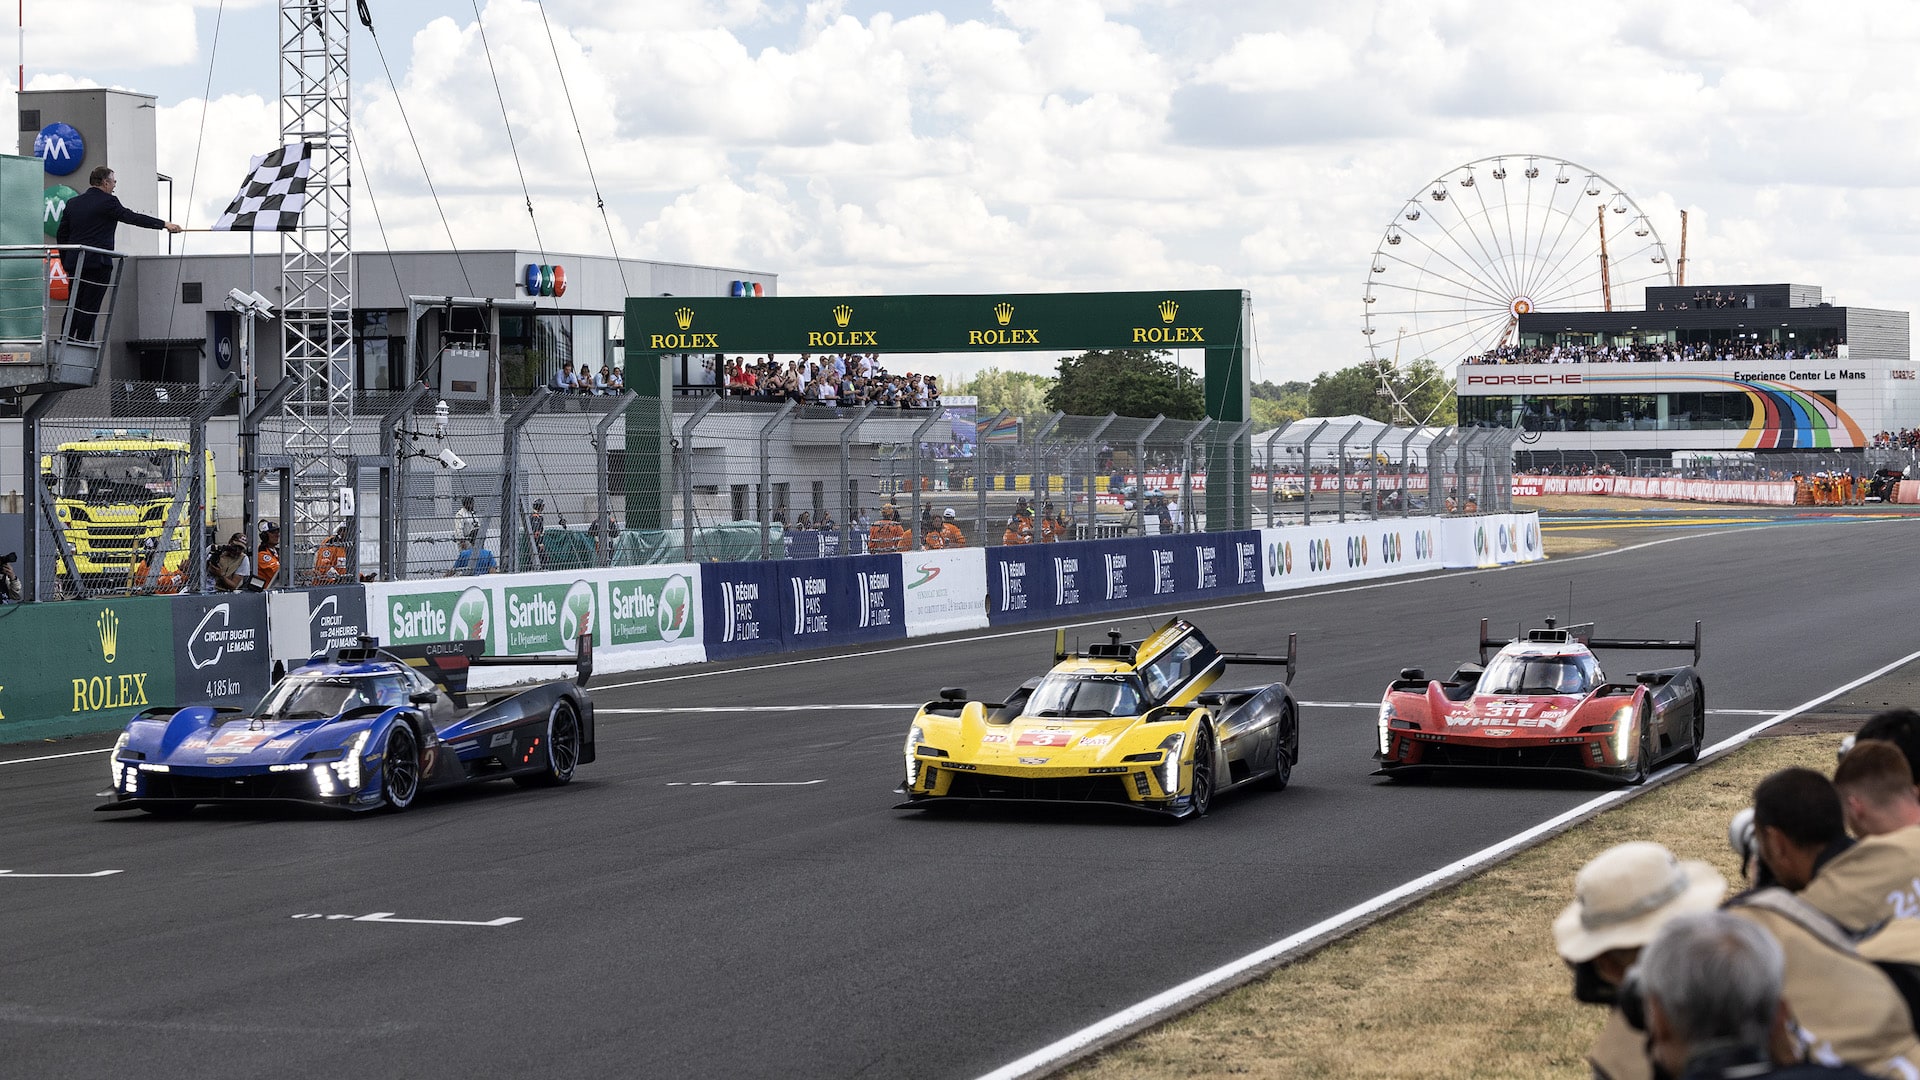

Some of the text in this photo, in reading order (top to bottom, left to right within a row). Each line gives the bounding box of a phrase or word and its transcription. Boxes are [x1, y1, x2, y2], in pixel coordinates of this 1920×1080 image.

[650, 333, 719, 349] ROLEX
[808, 331, 878, 347] ROLEX
[968, 329, 1040, 345] ROLEX
[1132, 327, 1205, 343] ROLEX
[1468, 374, 1582, 385] PORSCHE
[1734, 369, 1866, 383] Experience Center Le Mans
[1009, 560, 1027, 577] RÉGION
[805, 576, 827, 595] RÉGION
[869, 571, 890, 589] RÉGION
[1010, 579, 1022, 594] PAYS
[735, 581, 759, 601] RÉGION
[612, 586, 655, 620] Sarthe
[806, 597, 821, 614] PAYS
[870, 591, 885, 608] PAYS
[509, 592, 557, 629] Sarthe
[736, 602, 752, 621] PAYS
[876, 608, 891, 626] LOIRE
[321, 616, 343, 627] CIRCUIT
[393, 601, 447, 638] Sarthe
[812, 615, 828, 633] LOIRE
[204, 628, 255, 642] CIRCUIT BUGATTI
[335, 625, 358, 637] HEURES
[613, 623, 621, 637] Le
[742, 621, 760, 640] LOIRE
[234, 640, 255, 652] MANS
[331, 636, 358, 649] DU MANS
[510, 631, 548, 648] Le Département
[426, 643, 464, 655] CADILLAC
[72, 672, 149, 712] ROLEX
[205, 678, 241, 699] 4,185 km
[1444, 715, 1565, 729] WHELEN
[226, 735, 250, 748] 2
[1031, 734, 1057, 746] 3
[422, 749, 435, 779] 2
